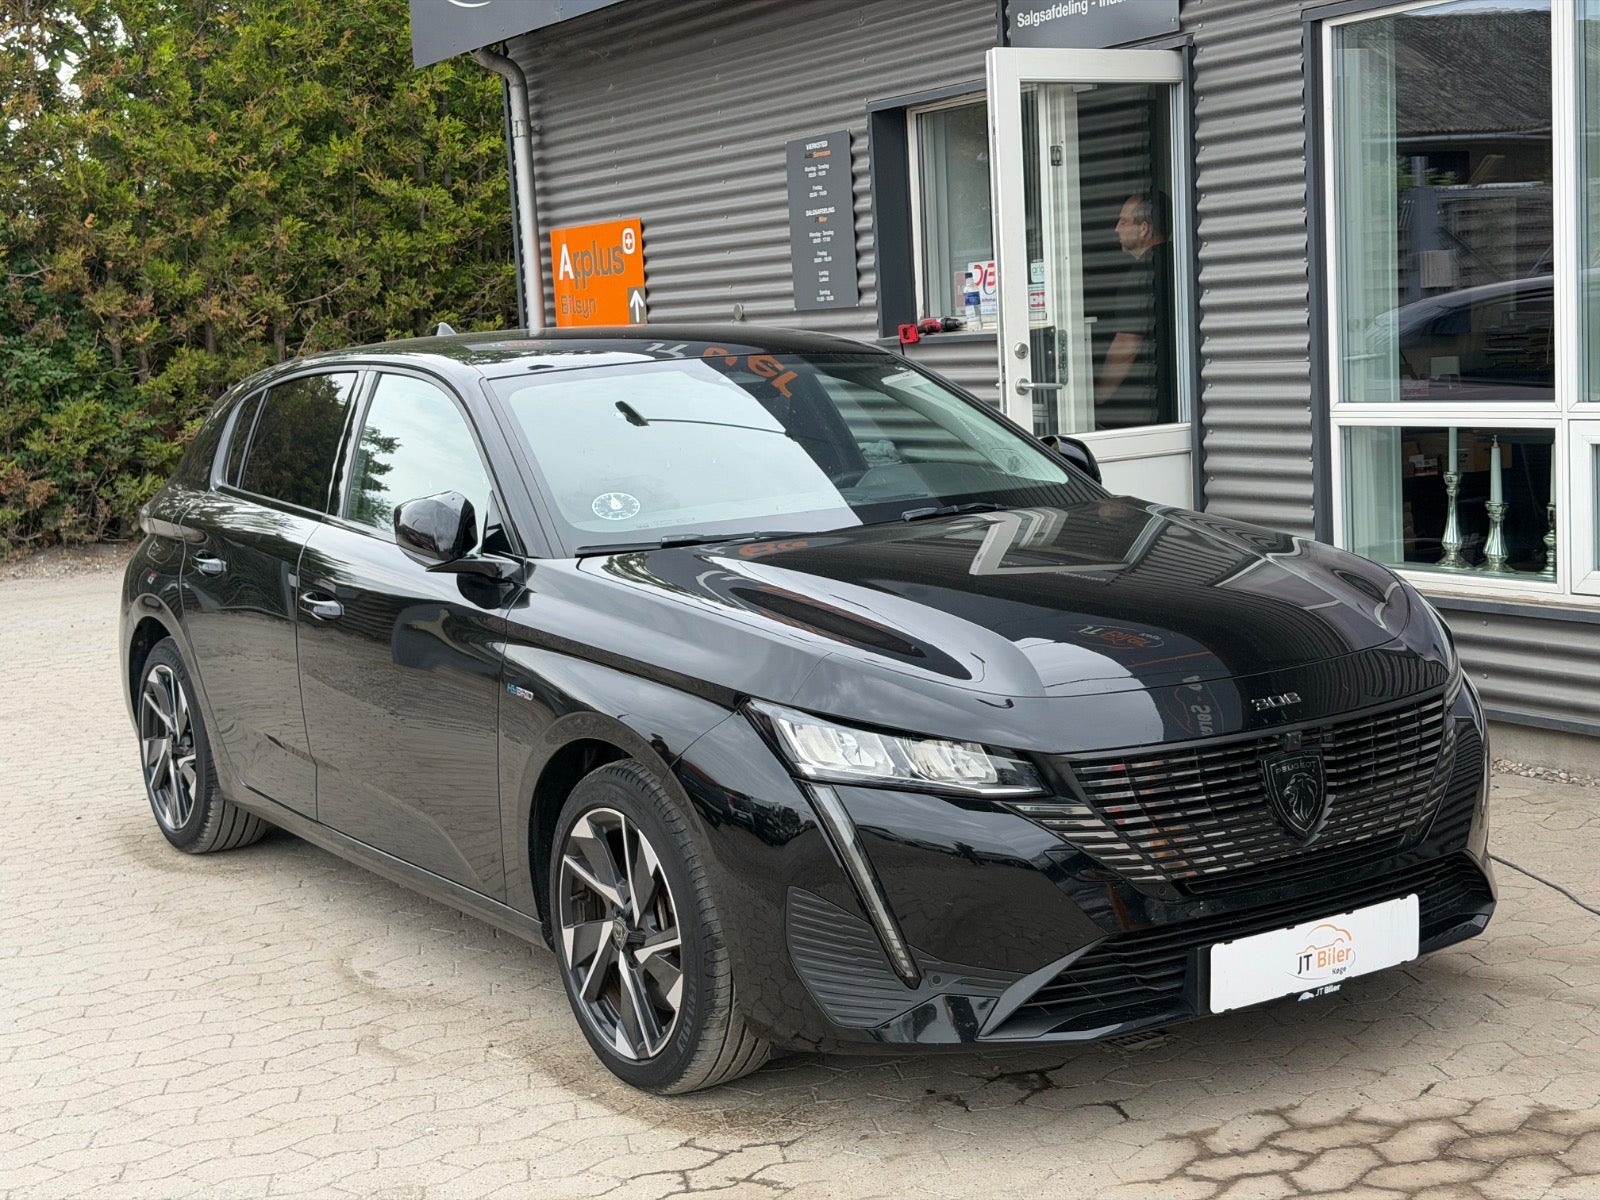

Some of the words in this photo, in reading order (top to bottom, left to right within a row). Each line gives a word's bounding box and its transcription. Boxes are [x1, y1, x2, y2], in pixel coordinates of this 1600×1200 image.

[1017, 0, 1088, 27] Salgsafdeling
[561, 294, 597, 320] Bilsyn
[1251, 692, 1302, 711] 308
[1275, 761, 1317, 774] PEUGEOT
[1297, 953, 1313, 975] JT
[1317, 947, 1352, 968] Biler
[1315, 988, 1324, 997] JT
[1324, 984, 1341, 994] Biler
